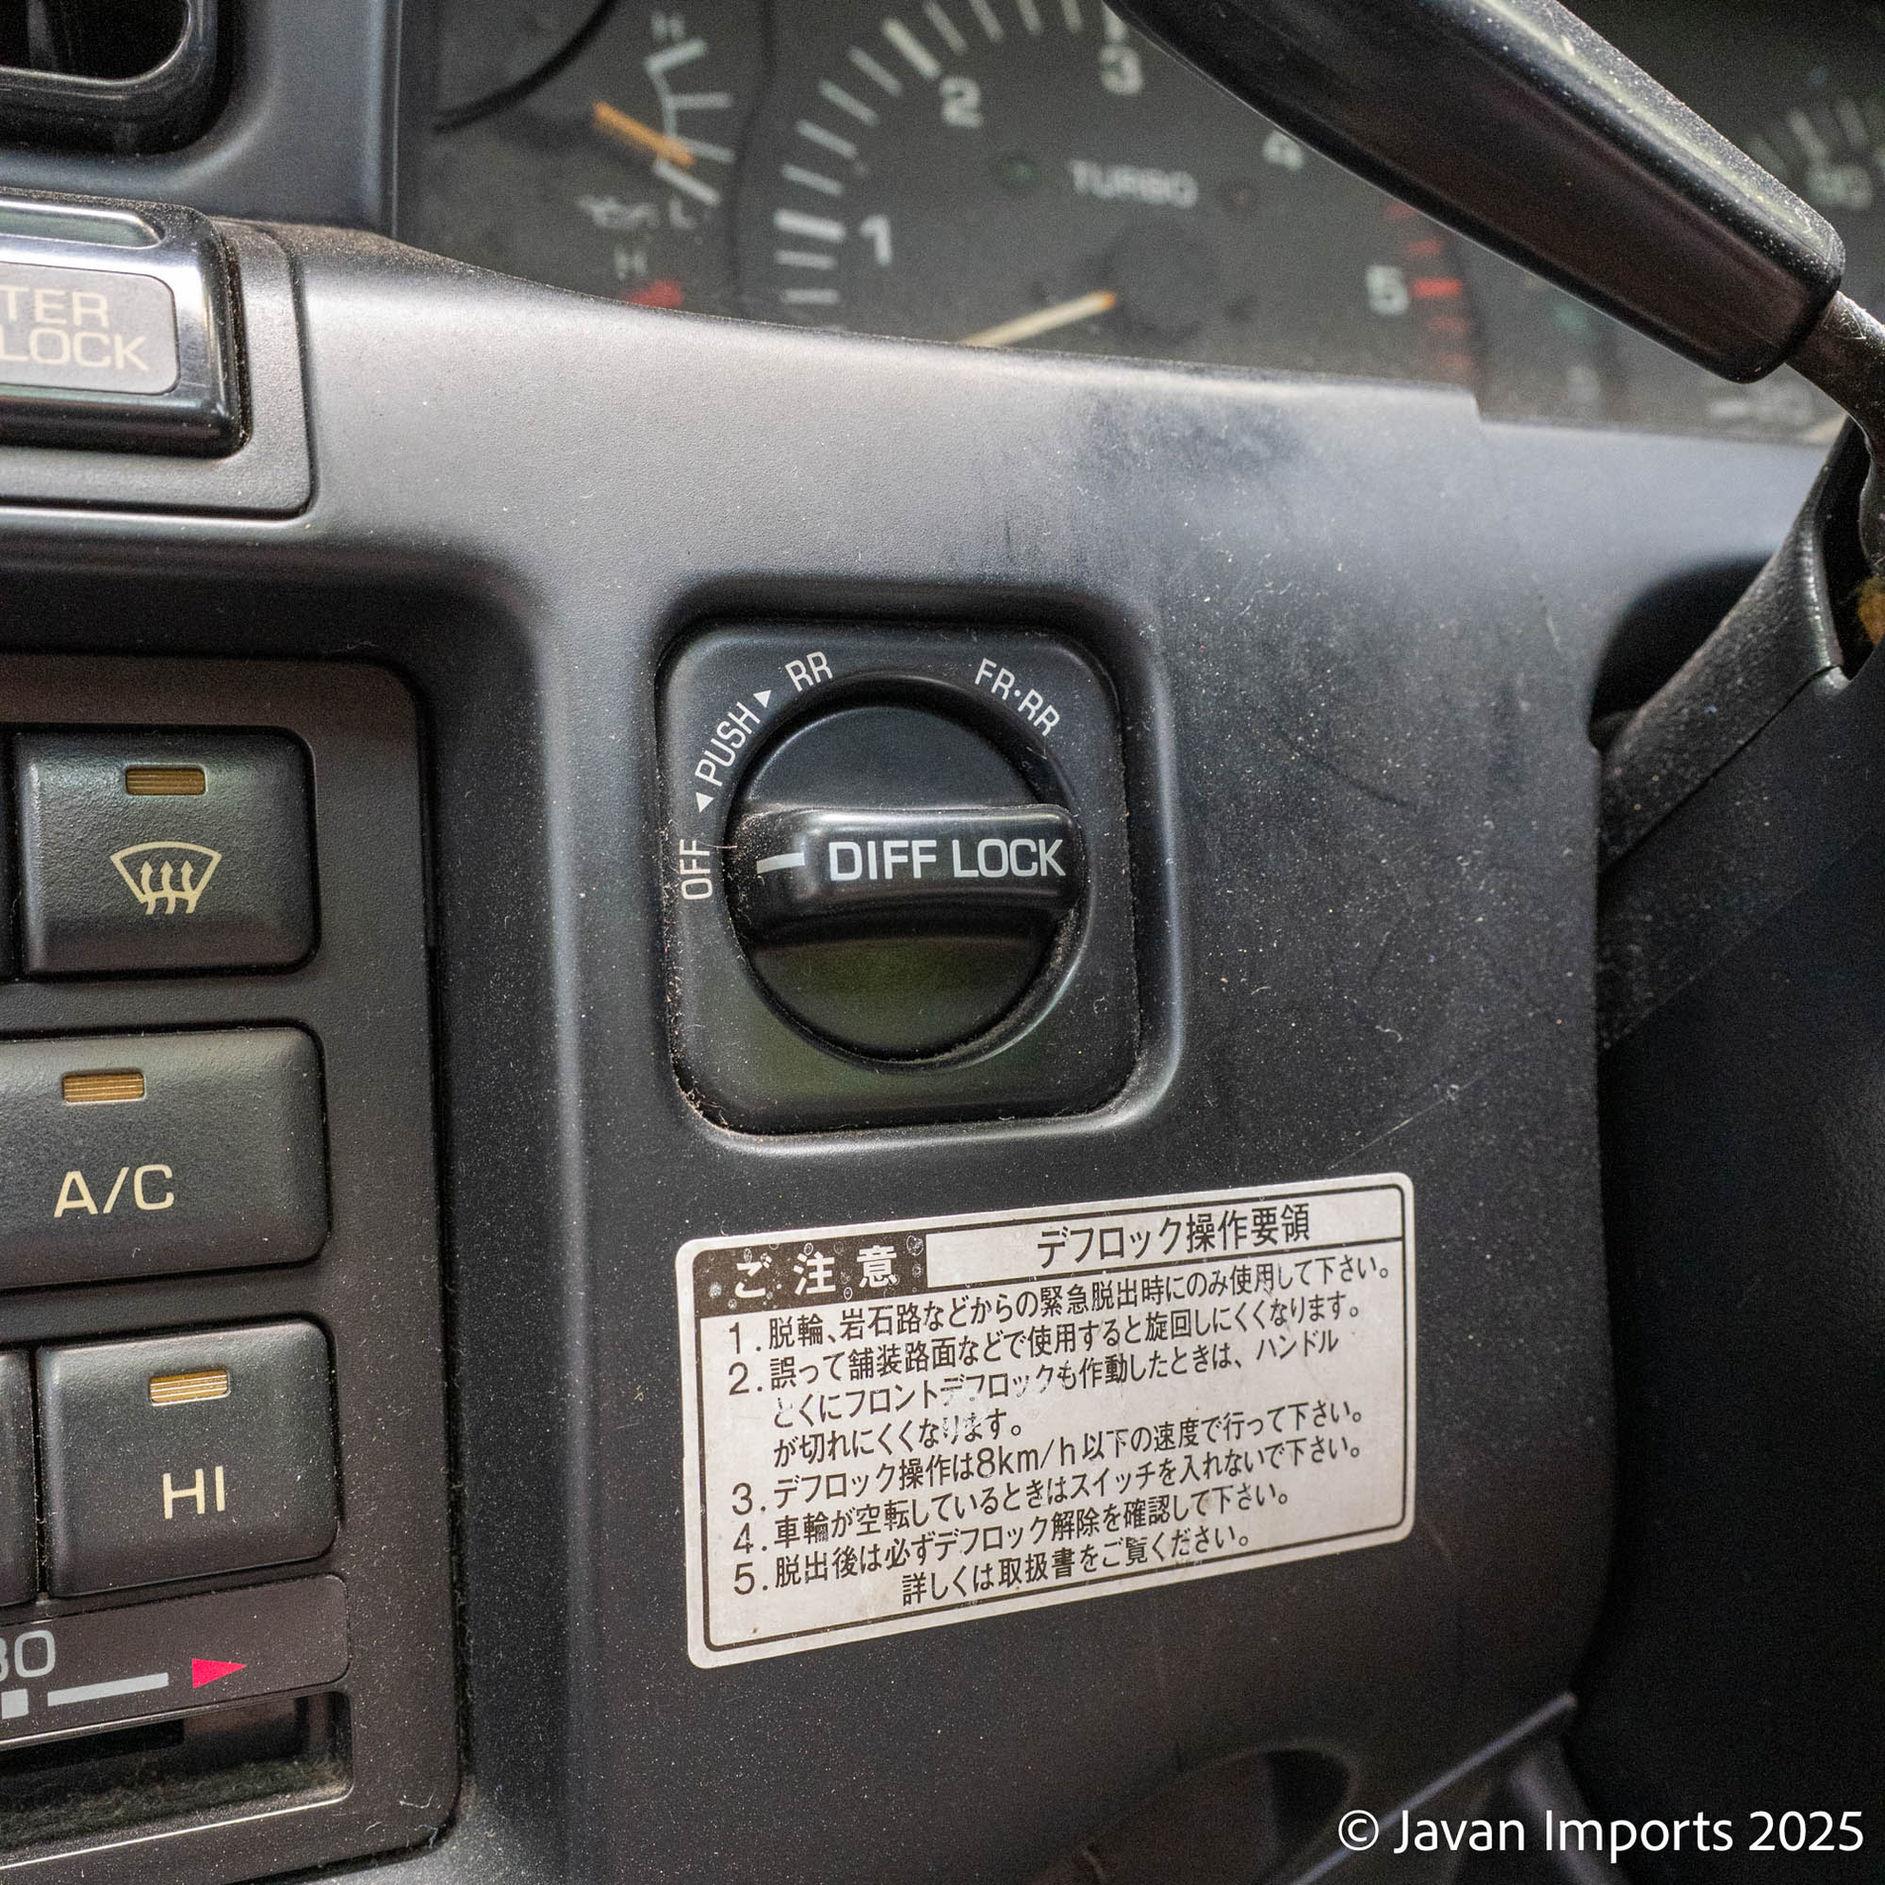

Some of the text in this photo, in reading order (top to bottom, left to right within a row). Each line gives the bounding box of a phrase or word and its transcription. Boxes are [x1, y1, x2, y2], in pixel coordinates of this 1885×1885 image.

[1100, 44, 1143, 95] 3
[940, 76, 982, 128] 2
[1070, 159, 1198, 209] TURBO
[861, 214, 892, 266] 1
[1366, 264, 1408, 315] 5
[0, 322, 149, 371] LOCK
[785, 651, 833, 692] RR
[695, 702, 761, 786] PUSH
[680, 839, 713, 900] OFF
[828, 838, 1066, 881] DIFF LOCK
[53, 1164, 176, 1218] A/C
[1037, 1203, 1310, 1269] デフロック操作要領
[734, 1244, 898, 1298] ご注意
[162, 1466, 226, 1520] HI
[0, 1630, 56, 1680] 0
